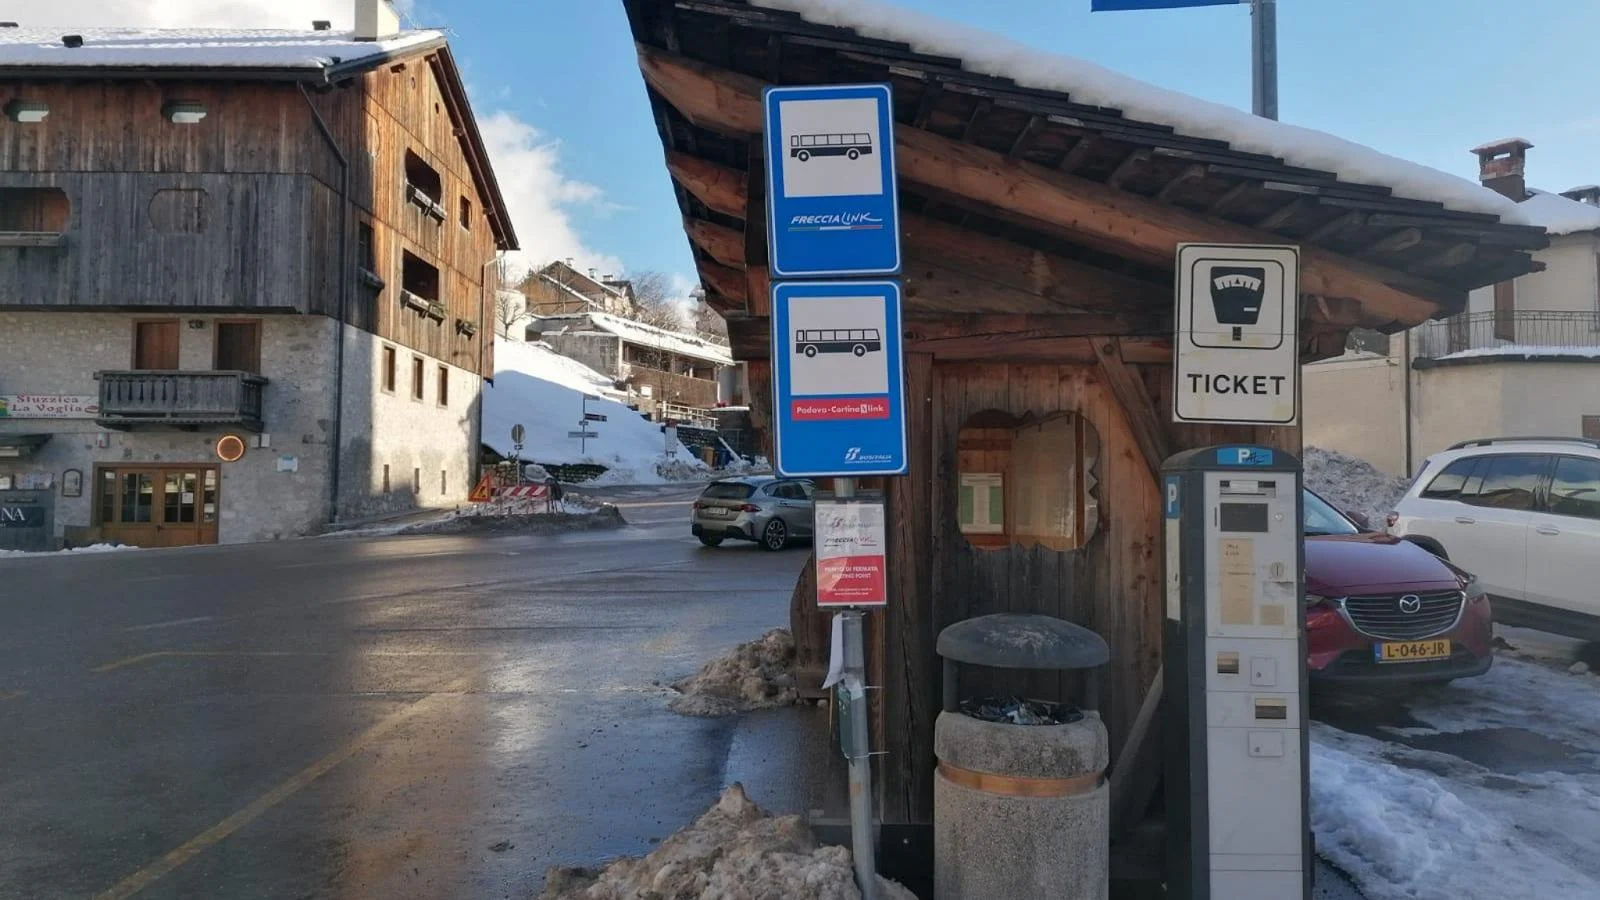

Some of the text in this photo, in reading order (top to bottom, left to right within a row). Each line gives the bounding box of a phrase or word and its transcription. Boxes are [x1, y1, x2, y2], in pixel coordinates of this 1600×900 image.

[791, 212, 883, 225] FRECCIALINK
[1187, 373, 1286, 395] TICKET
[16, 392, 79, 403] Stuzzica
[12, 404, 82, 413] La Voglia
[867, 404, 884, 413] link
[1238, 448, 1250, 464] P
[1167, 484, 1178, 512] P
[1387, 642, 1445, 658] L-046-JR
